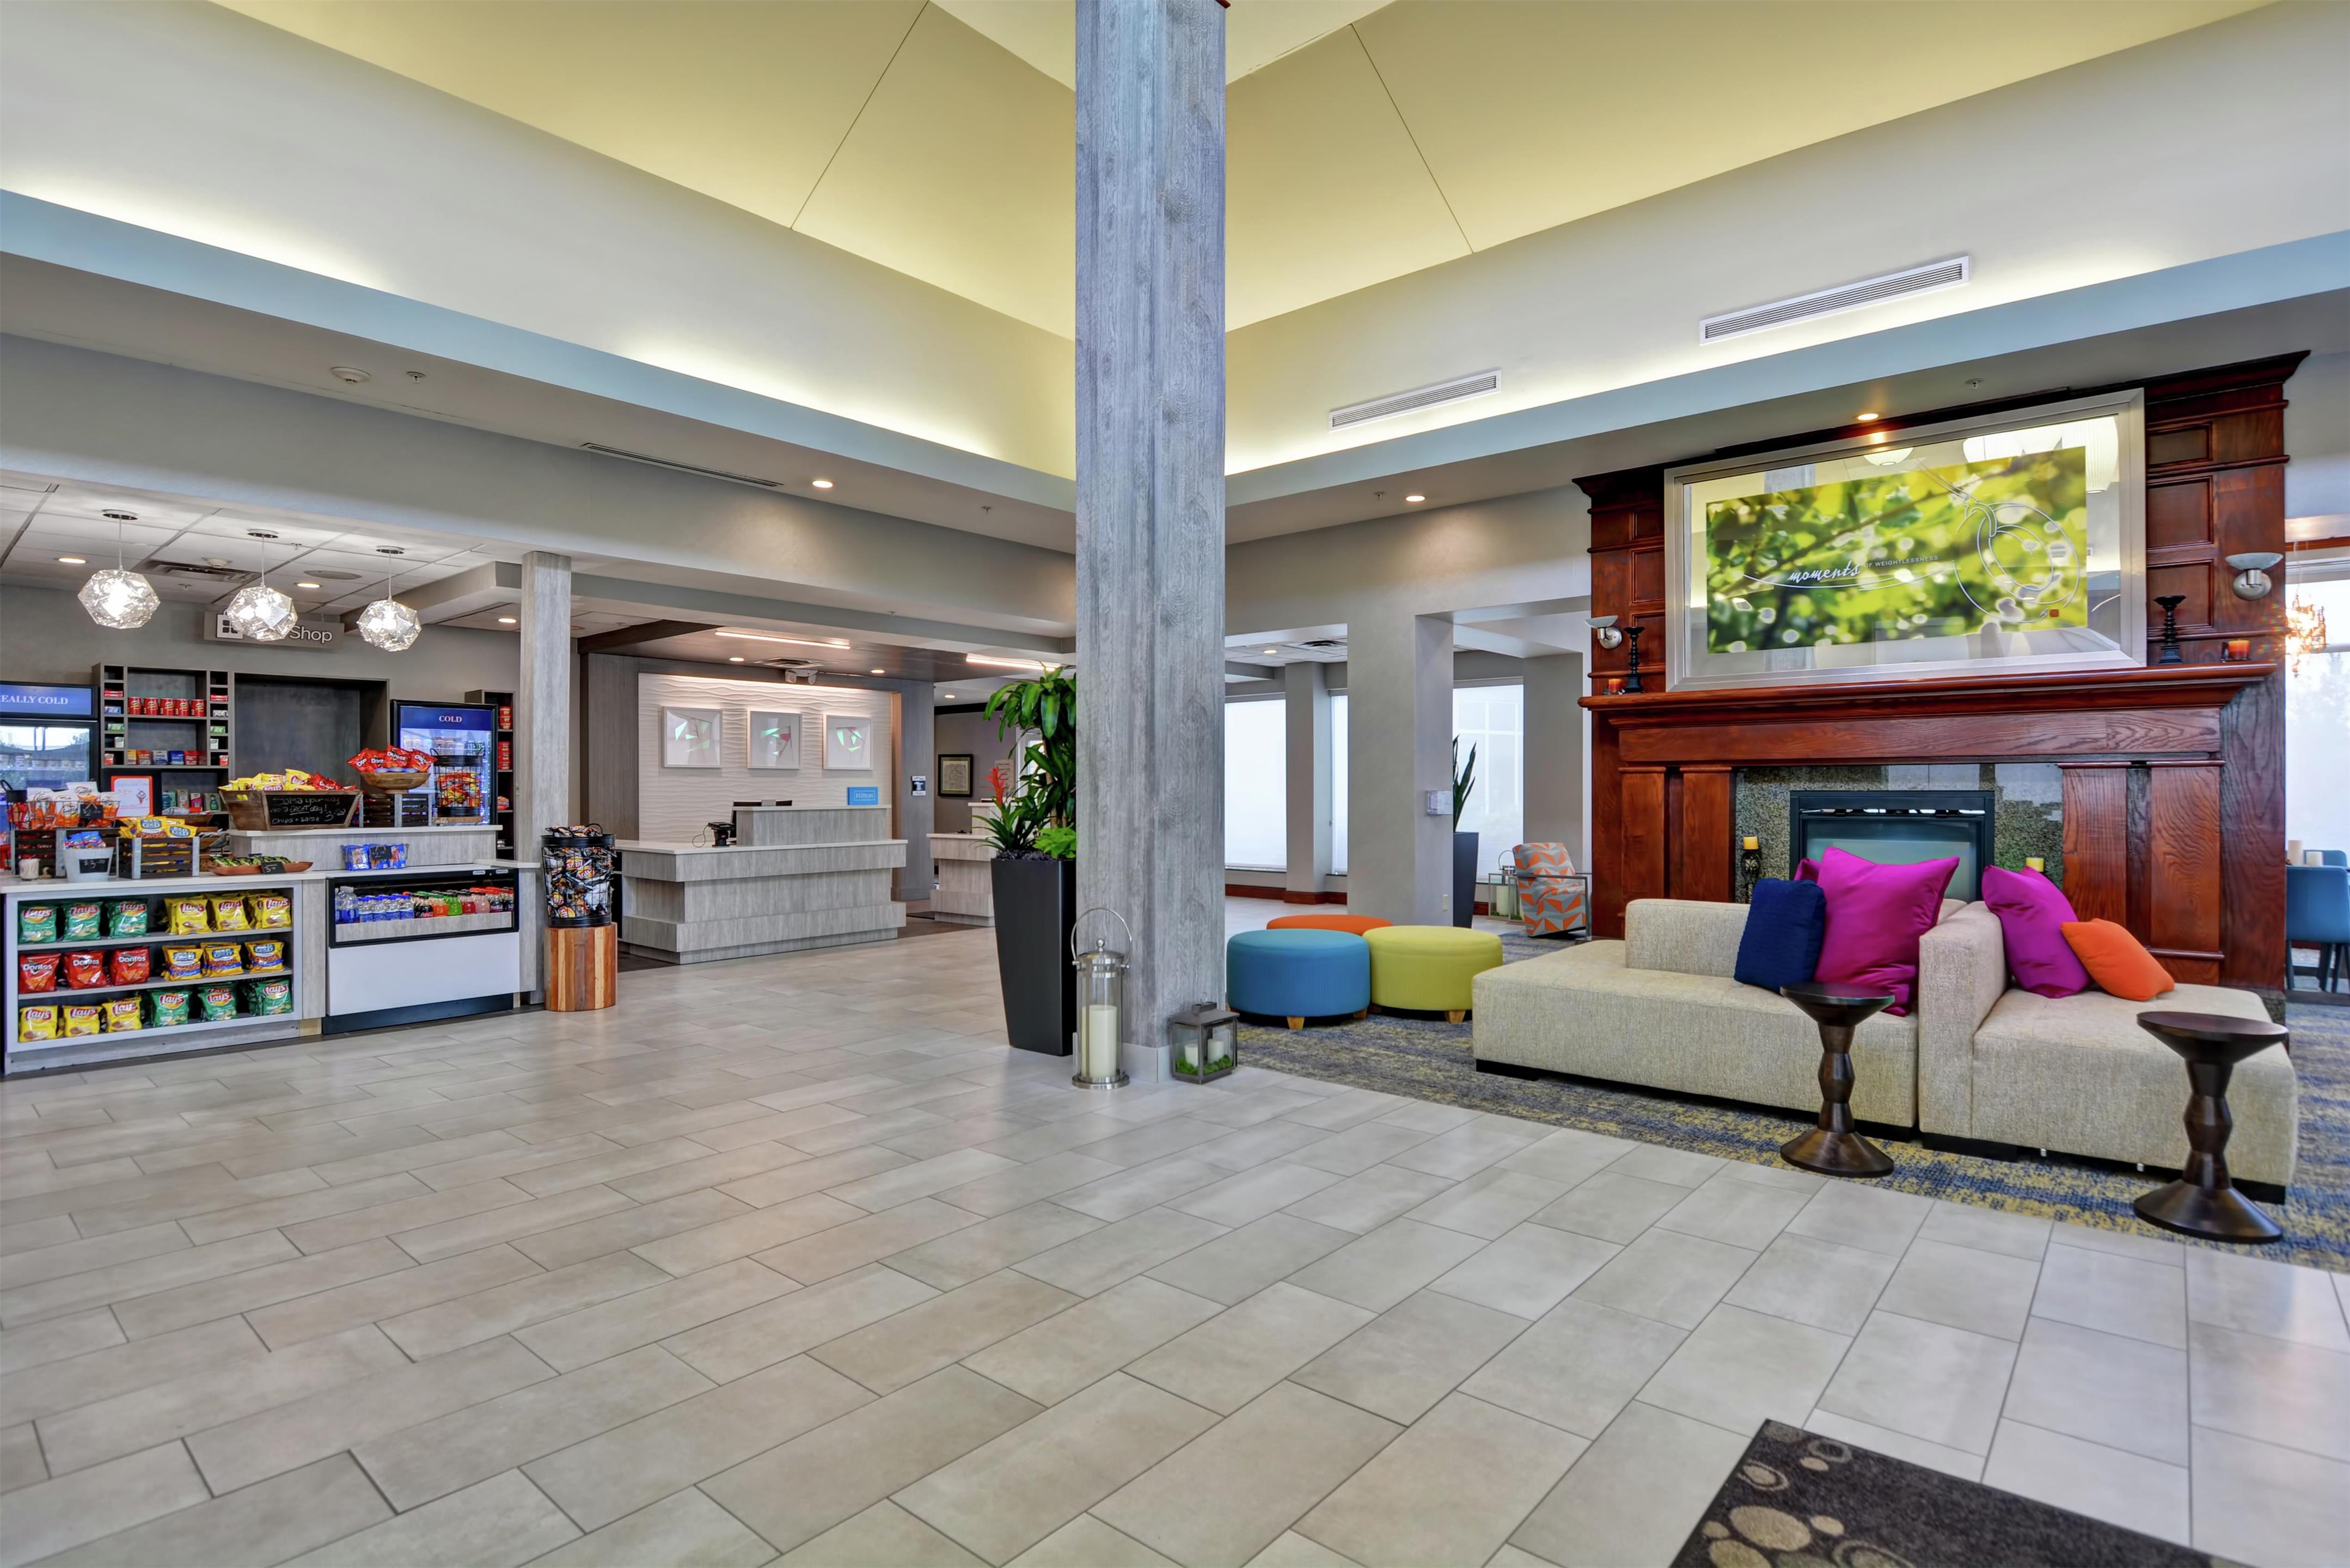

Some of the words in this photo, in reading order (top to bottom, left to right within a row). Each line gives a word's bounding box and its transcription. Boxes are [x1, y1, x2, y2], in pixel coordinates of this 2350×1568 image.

[1788, 560, 1861, 583] moments
[1876, 555, 1939, 567] WEIGHTLESSNESS
[290, 625, 333, 644] Shop
[0, 695, 36, 703] EALLY
[38, 696, 69, 705] COLD
